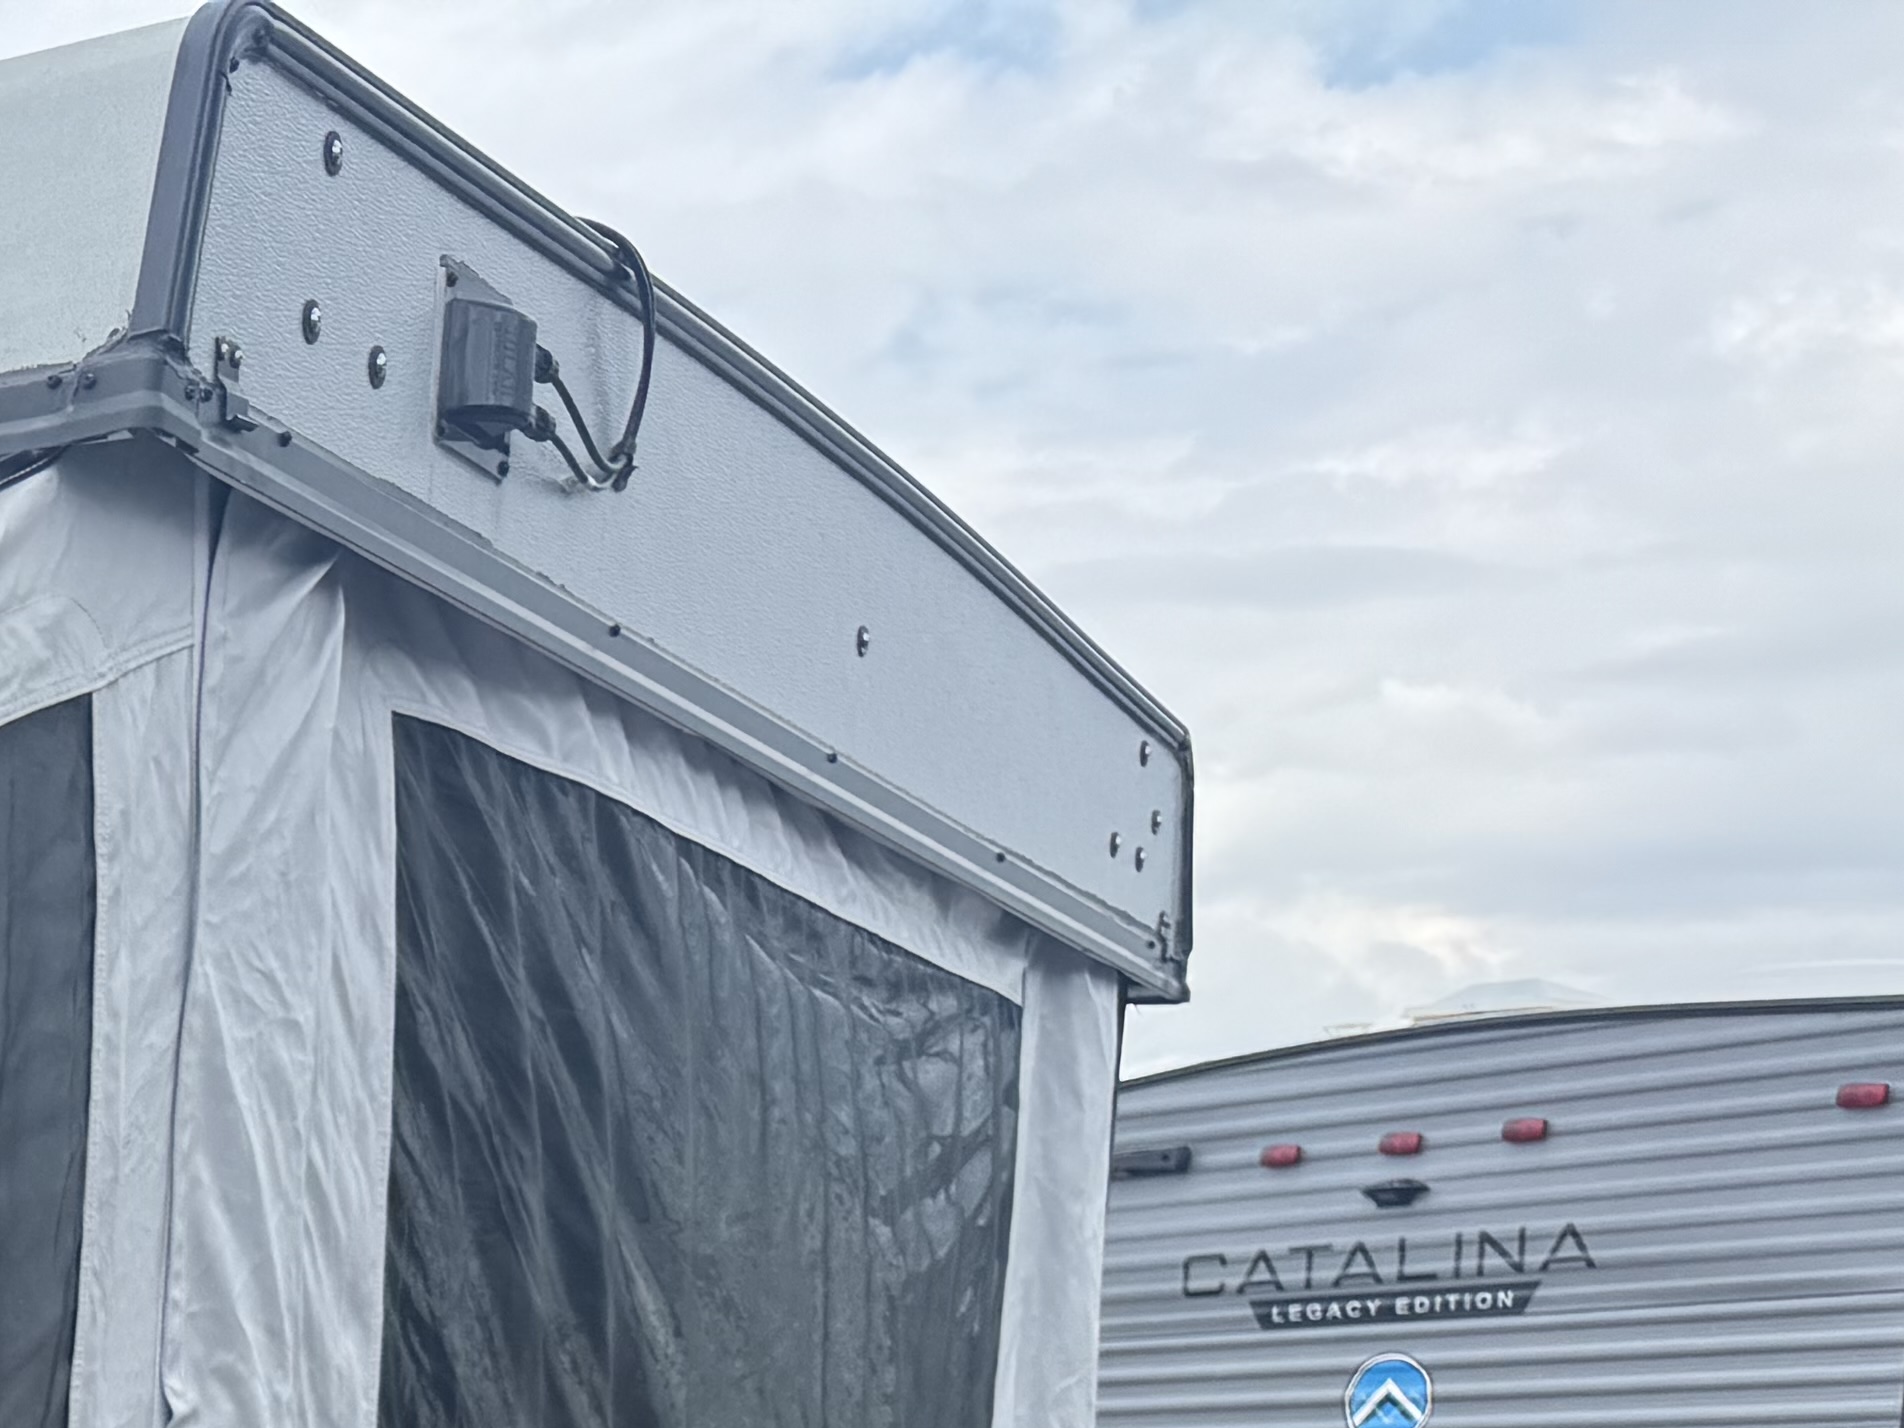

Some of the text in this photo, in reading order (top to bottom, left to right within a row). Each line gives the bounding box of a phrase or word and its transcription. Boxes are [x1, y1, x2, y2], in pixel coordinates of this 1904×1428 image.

[1182, 1223, 1597, 1297] CATALINA
[1270, 1289, 1515, 1325] LEGACY EDITION
